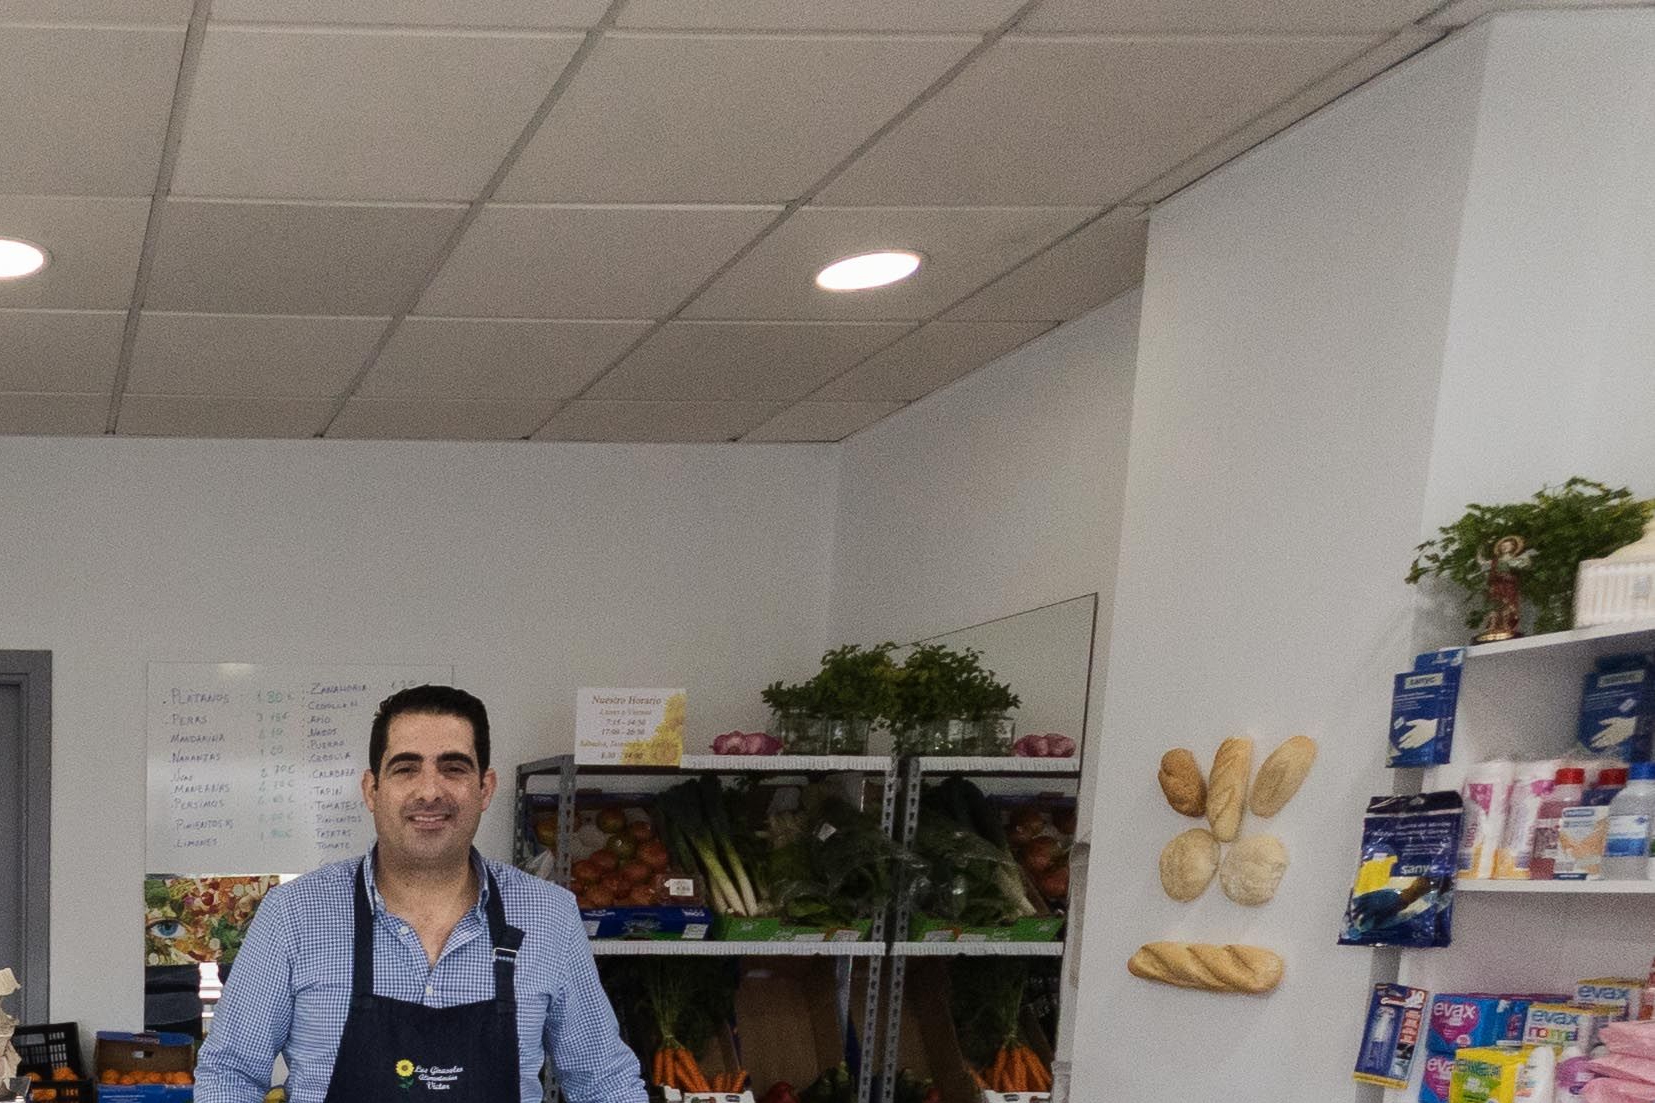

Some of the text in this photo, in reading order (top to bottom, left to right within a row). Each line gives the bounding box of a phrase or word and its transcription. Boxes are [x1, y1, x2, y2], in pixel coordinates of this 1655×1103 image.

[1578, 985, 1629, 1000] evax
[1432, 1001, 1477, 1019] evax
[1531, 1010, 1579, 1026] evax
[1426, 1056, 1454, 1073] eva
